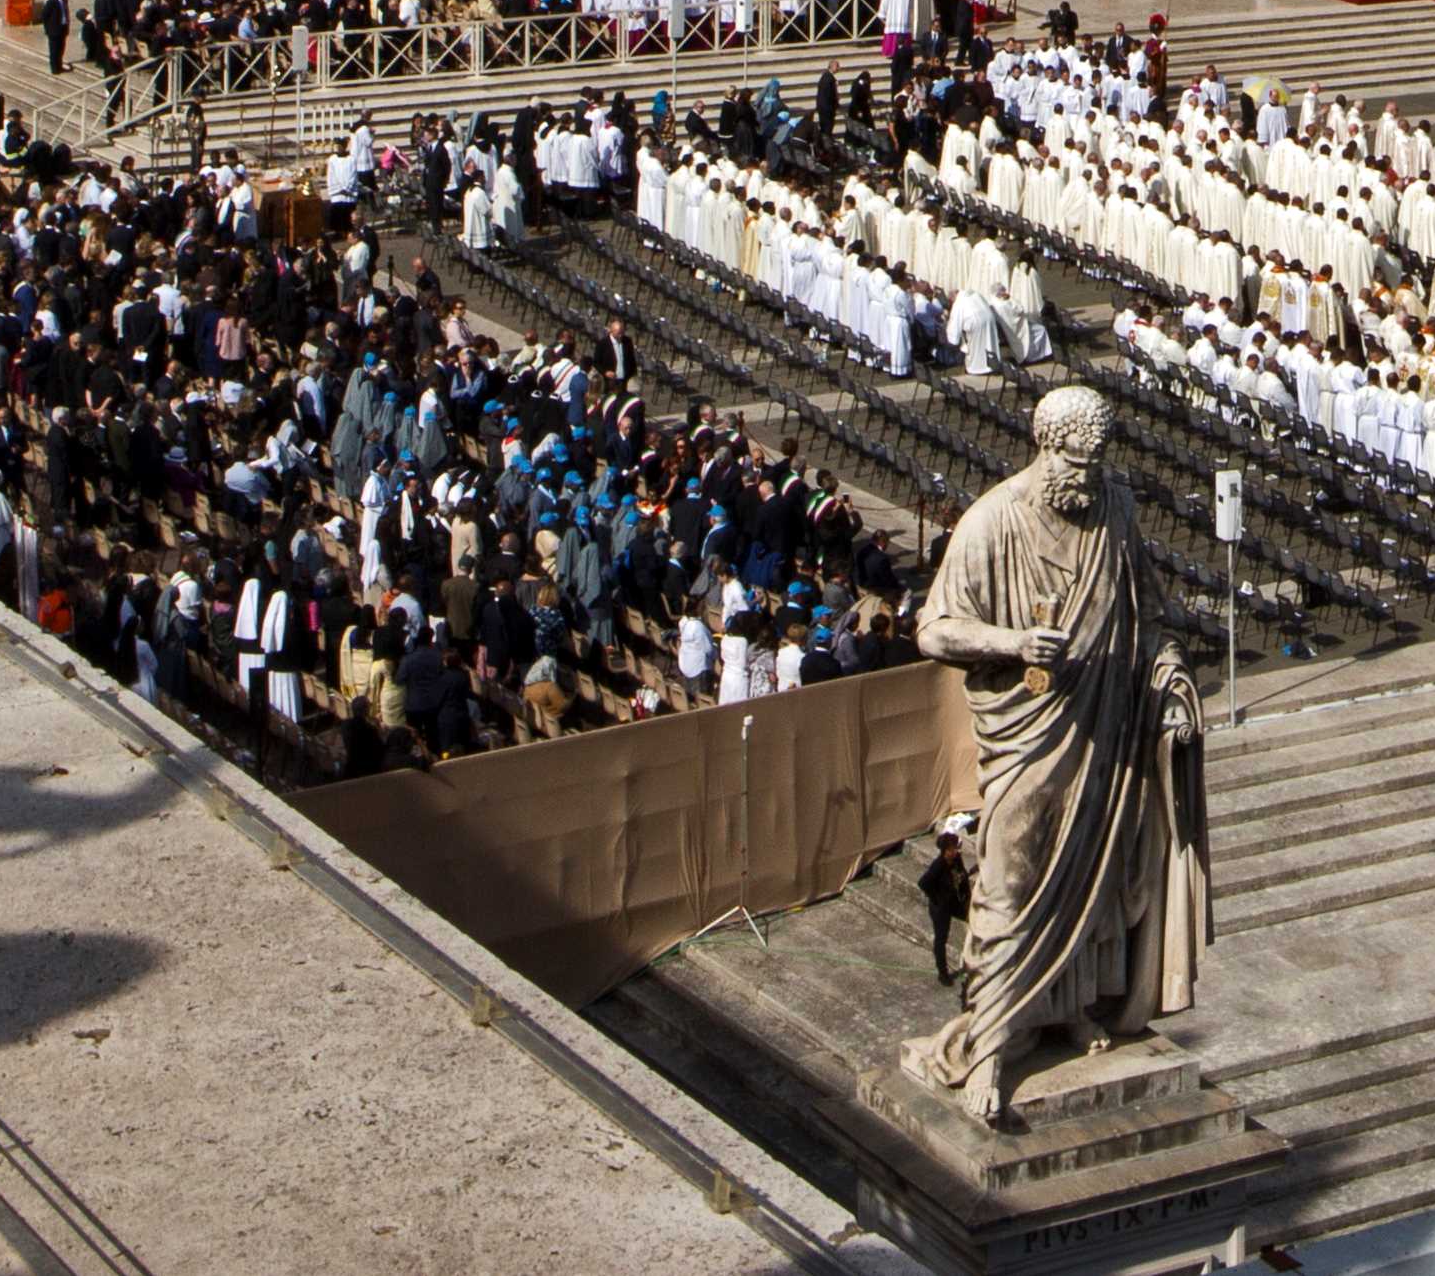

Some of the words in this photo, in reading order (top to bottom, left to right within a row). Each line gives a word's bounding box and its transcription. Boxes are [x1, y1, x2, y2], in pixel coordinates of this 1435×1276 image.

[1024, 1218, 1088, 1254] PIVS
[1112, 1204, 1142, 1232] IX
[1189, 1188, 1210, 1212] M
